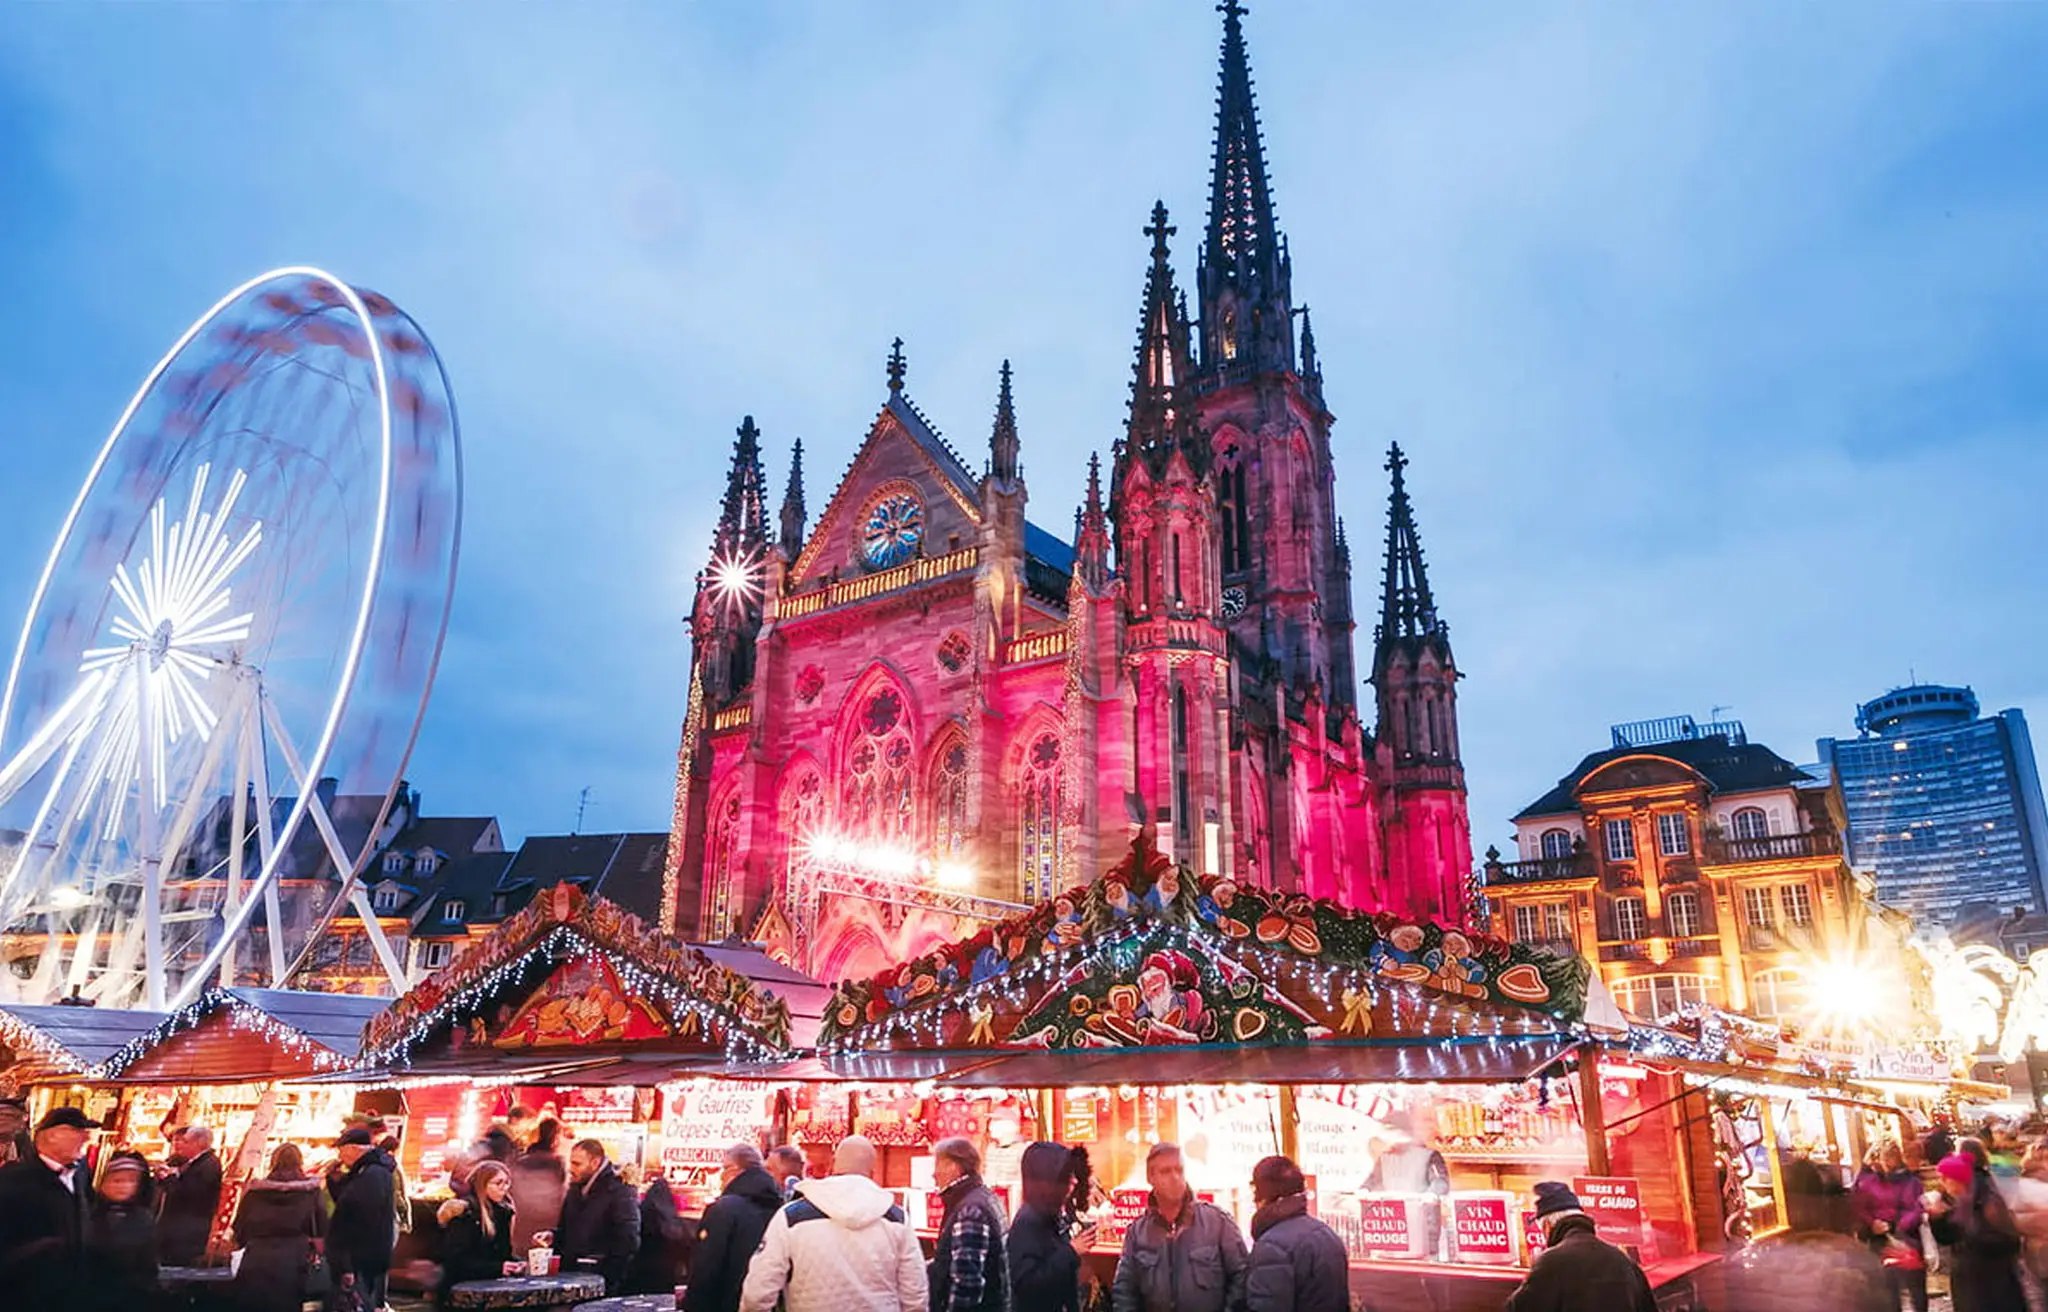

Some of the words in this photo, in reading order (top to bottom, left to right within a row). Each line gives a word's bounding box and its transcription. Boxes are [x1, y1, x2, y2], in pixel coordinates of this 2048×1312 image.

[1897, 1050, 1924, 1064] Vin
[1889, 1062, 1934, 1076] Chaud
[698, 1094, 753, 1114] Gaufres
[663, 1148, 727, 1162] FABRICATIO
[1122, 1195, 1141, 1205] VIN
[1578, 1196, 1595, 1207] VIN
[1599, 1196, 1637, 1209] CHAUD
[1115, 1207, 1147, 1217] CHAU
[1372, 1206, 1395, 1217] VIN
[1466, 1206, 1493, 1218] VIN
[1363, 1219, 1406, 1232] CHAUD
[1457, 1219, 1506, 1232] CHAUD
[1365, 1232, 1408, 1244] ROUGE
[1459, 1233, 1508, 1246] BLANC
